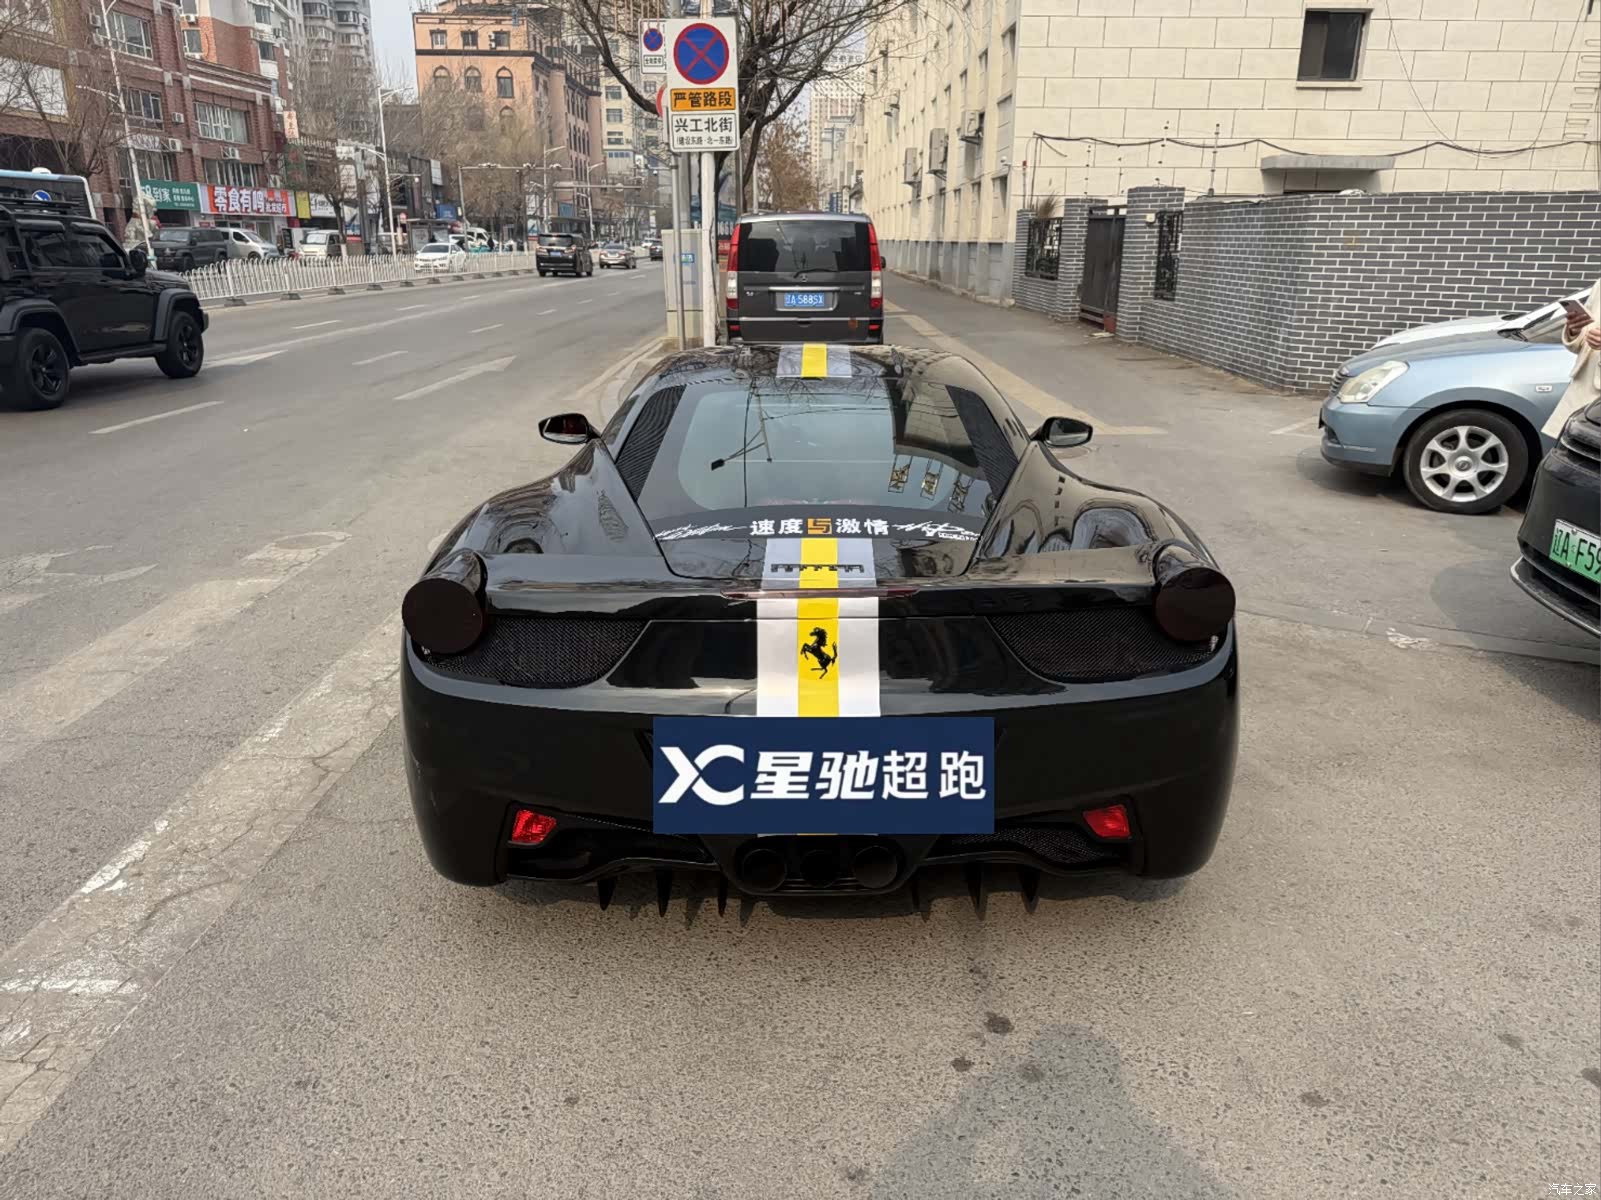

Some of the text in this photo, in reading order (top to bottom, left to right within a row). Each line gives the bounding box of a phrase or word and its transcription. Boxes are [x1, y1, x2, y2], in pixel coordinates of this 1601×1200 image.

[674, 91, 732, 108] 严管路段
[674, 117, 732, 132] 兴工北街
[214, 187, 264, 212] 零食有鸣
[749, 517, 889, 536] 速度与激情
